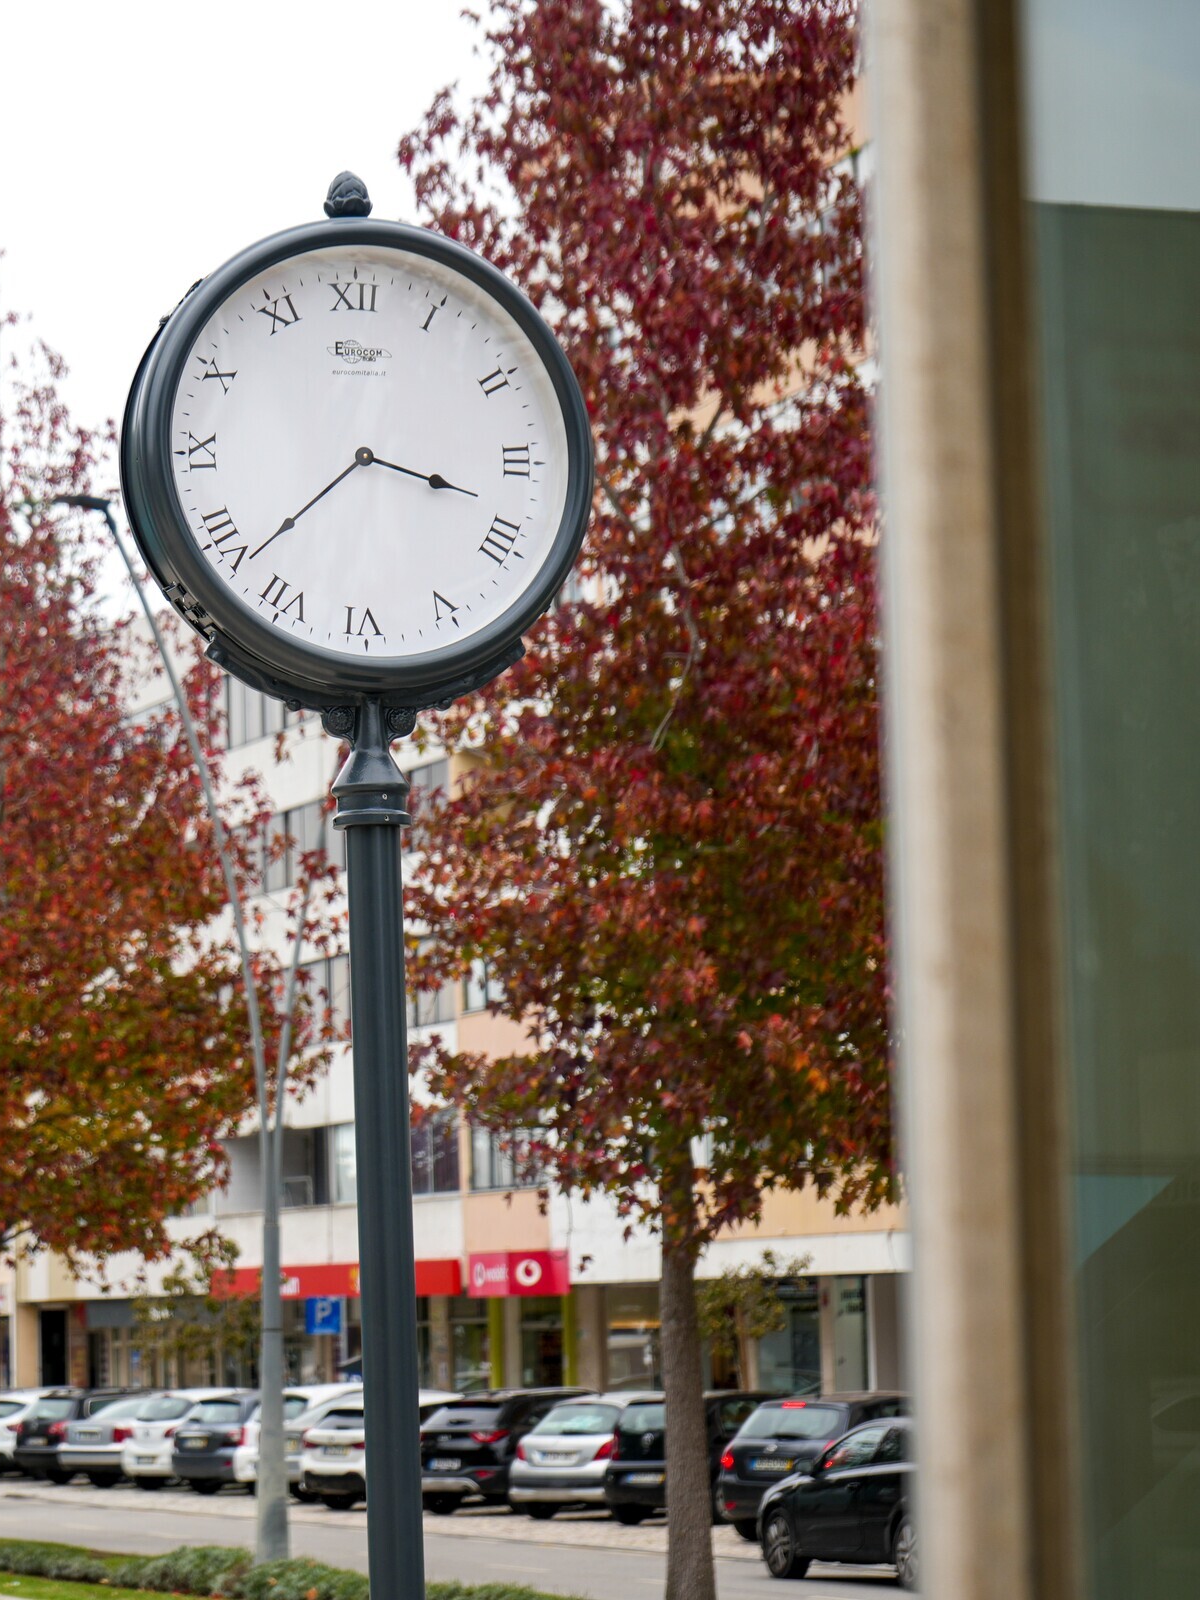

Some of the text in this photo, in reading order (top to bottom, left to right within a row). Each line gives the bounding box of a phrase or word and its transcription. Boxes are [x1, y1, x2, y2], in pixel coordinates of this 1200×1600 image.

[257, 293, 303, 336] XI
[327, 282, 380, 313] XII
[419, 302, 441, 333] I
[201, 356, 238, 395] X
[477, 366, 511, 398] II
[188, 430, 217, 472] IX
[502, 443, 531, 480] III
[201, 504, 250, 574] VIII
[477, 513, 521, 568] IIII
[257, 572, 306, 625] VII
[432, 589, 460, 622] V
[342, 605, 384, 637] VI
[315, 1301, 333, 1324] P
